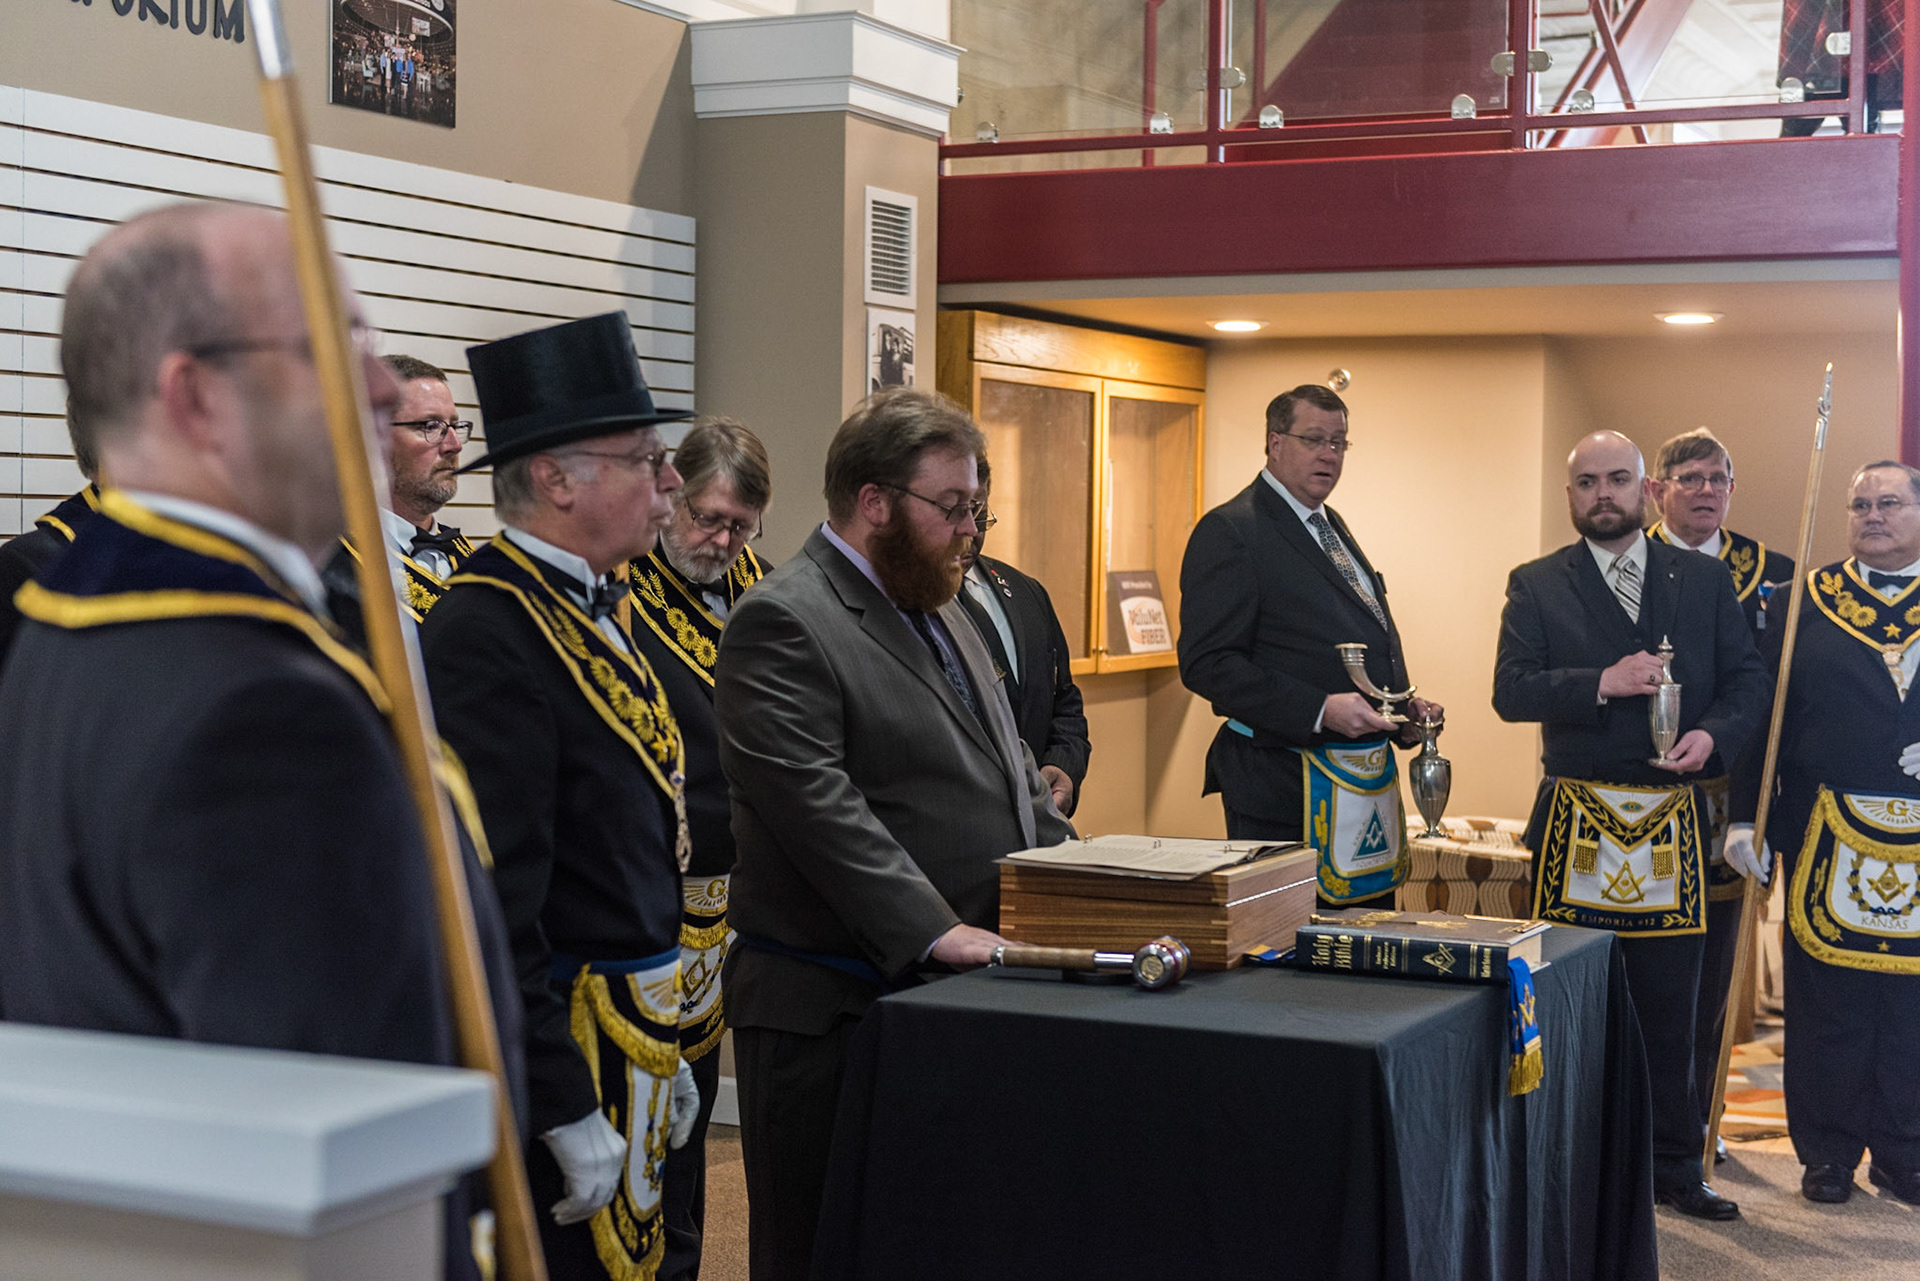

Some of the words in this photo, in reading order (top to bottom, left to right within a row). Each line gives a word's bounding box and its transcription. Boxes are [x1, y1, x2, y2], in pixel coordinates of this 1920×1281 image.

[1886, 799, 1909, 817] G
[1580, 913, 1634, 927] EMPORIA
[1861, 915, 1909, 930] KANSAS
[1311, 934, 1334, 966] Holy
[1334, 934, 1353, 970] Bible
